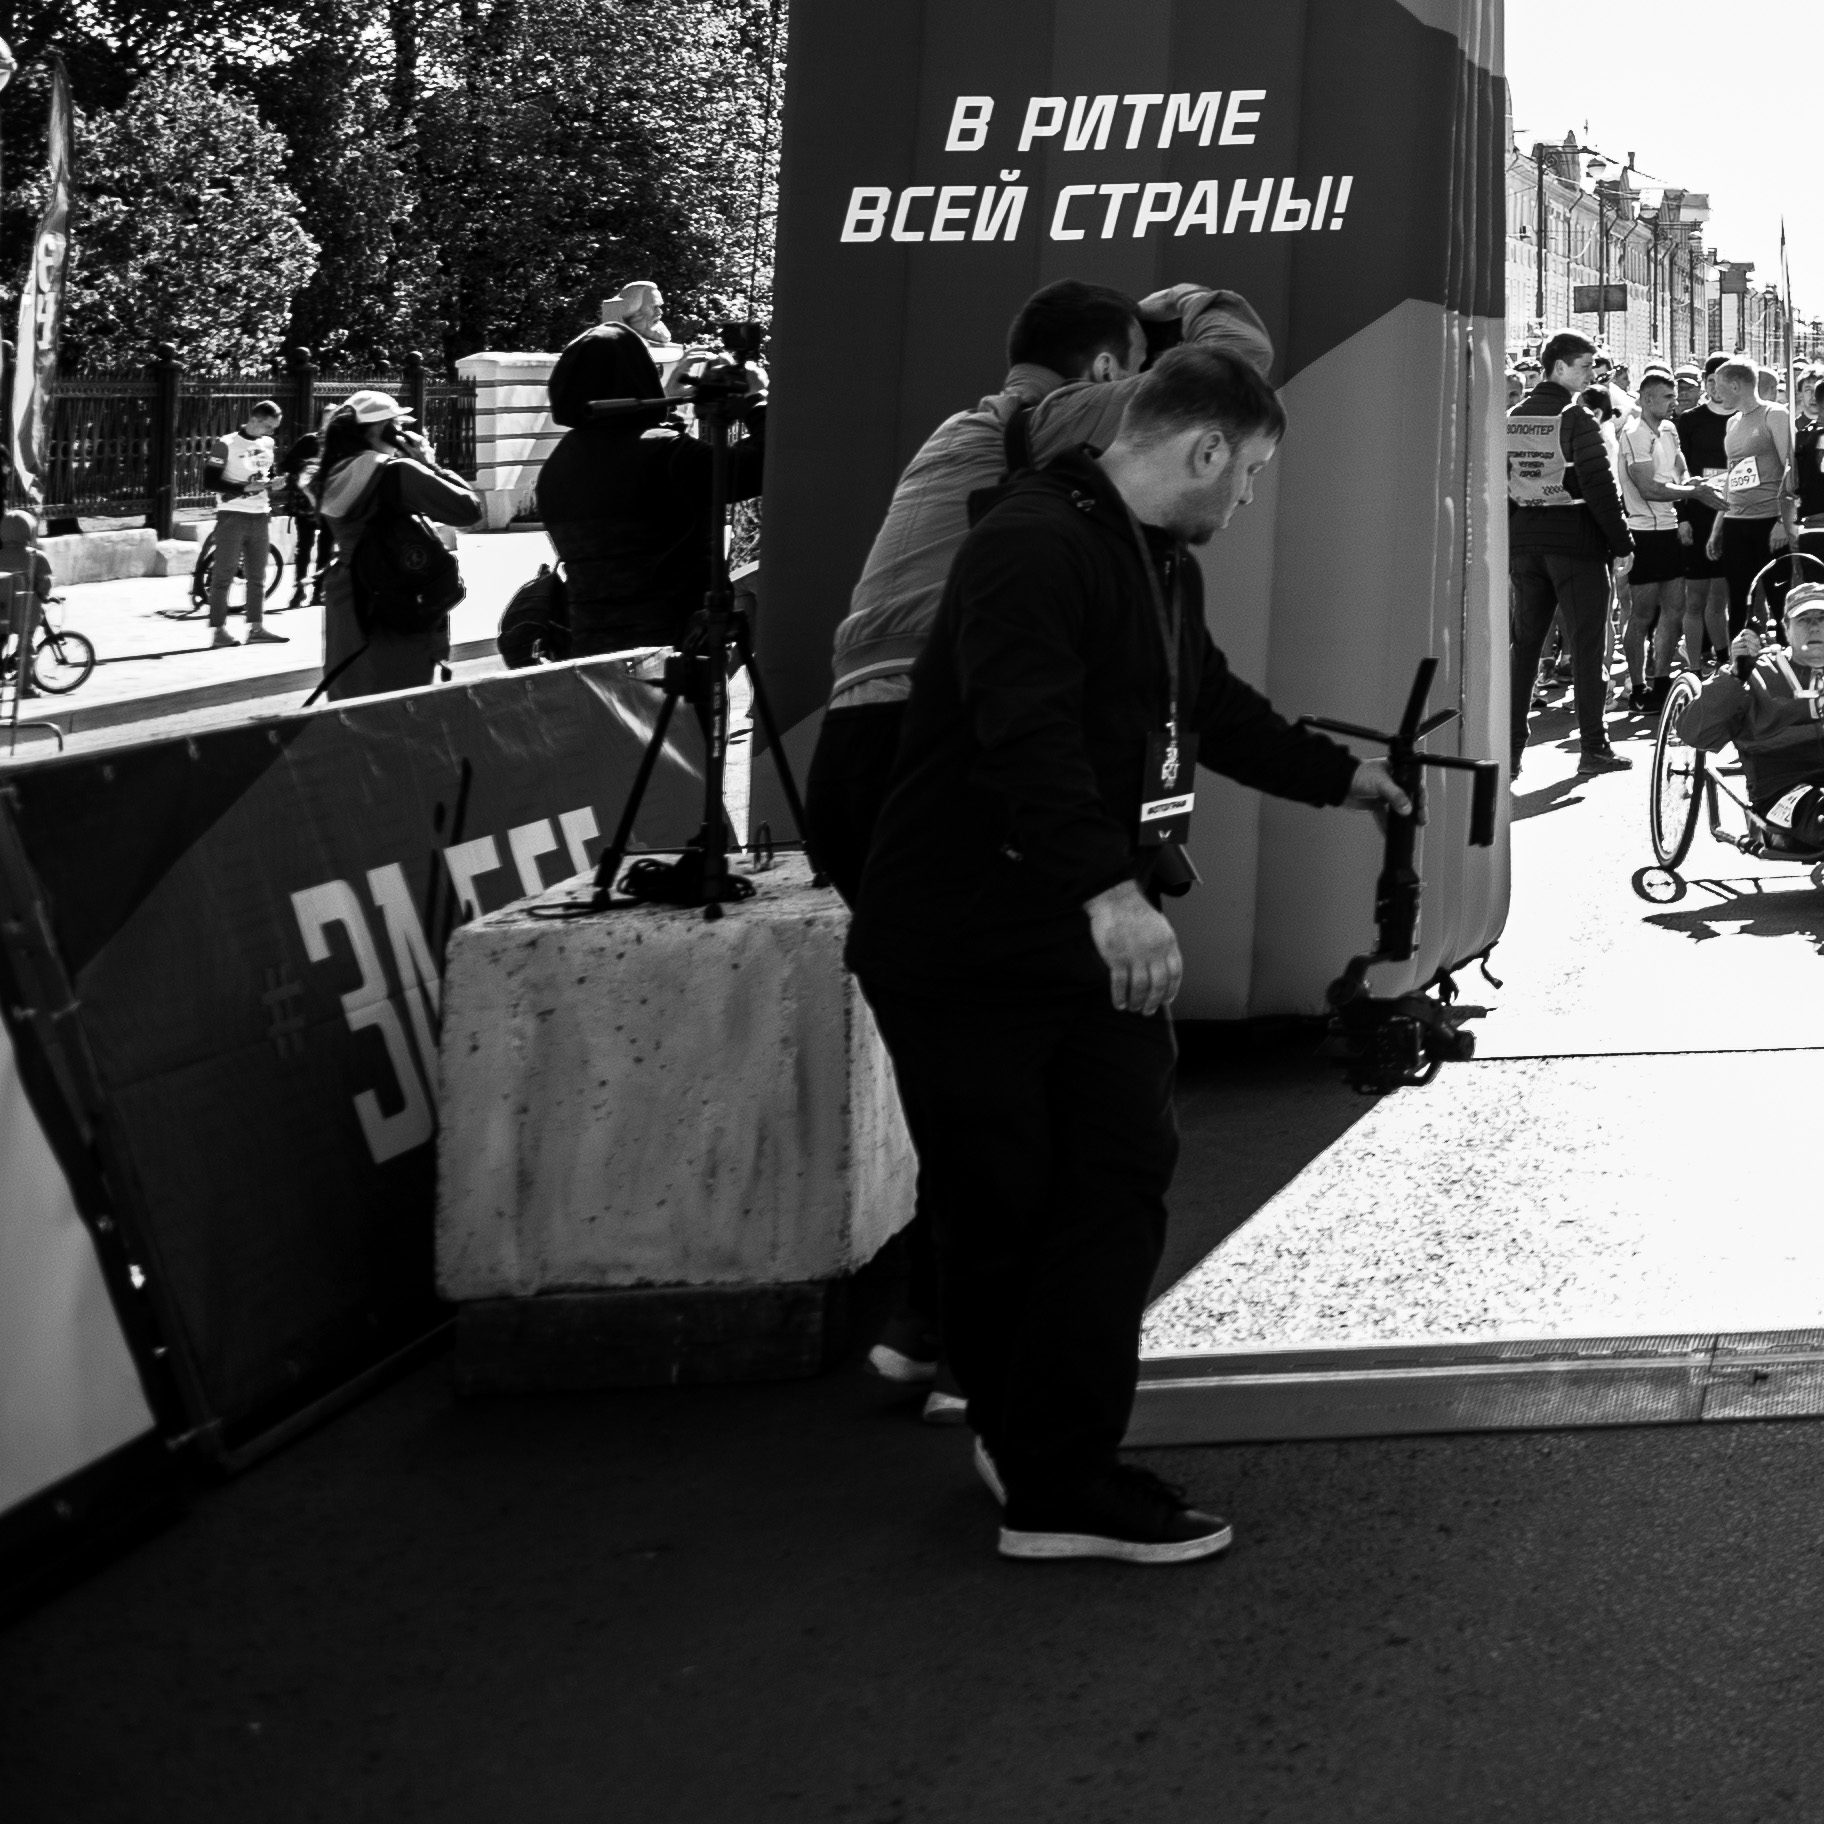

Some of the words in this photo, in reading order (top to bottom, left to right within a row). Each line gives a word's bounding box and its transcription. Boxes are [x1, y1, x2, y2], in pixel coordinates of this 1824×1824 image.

[945, 96, 994, 151] В
[1018, 89, 1267, 152] РИТМЕ
[840, 169, 1029, 243] ВСЕЙ
[1049, 176, 1354, 240] СТРАНЫ!
